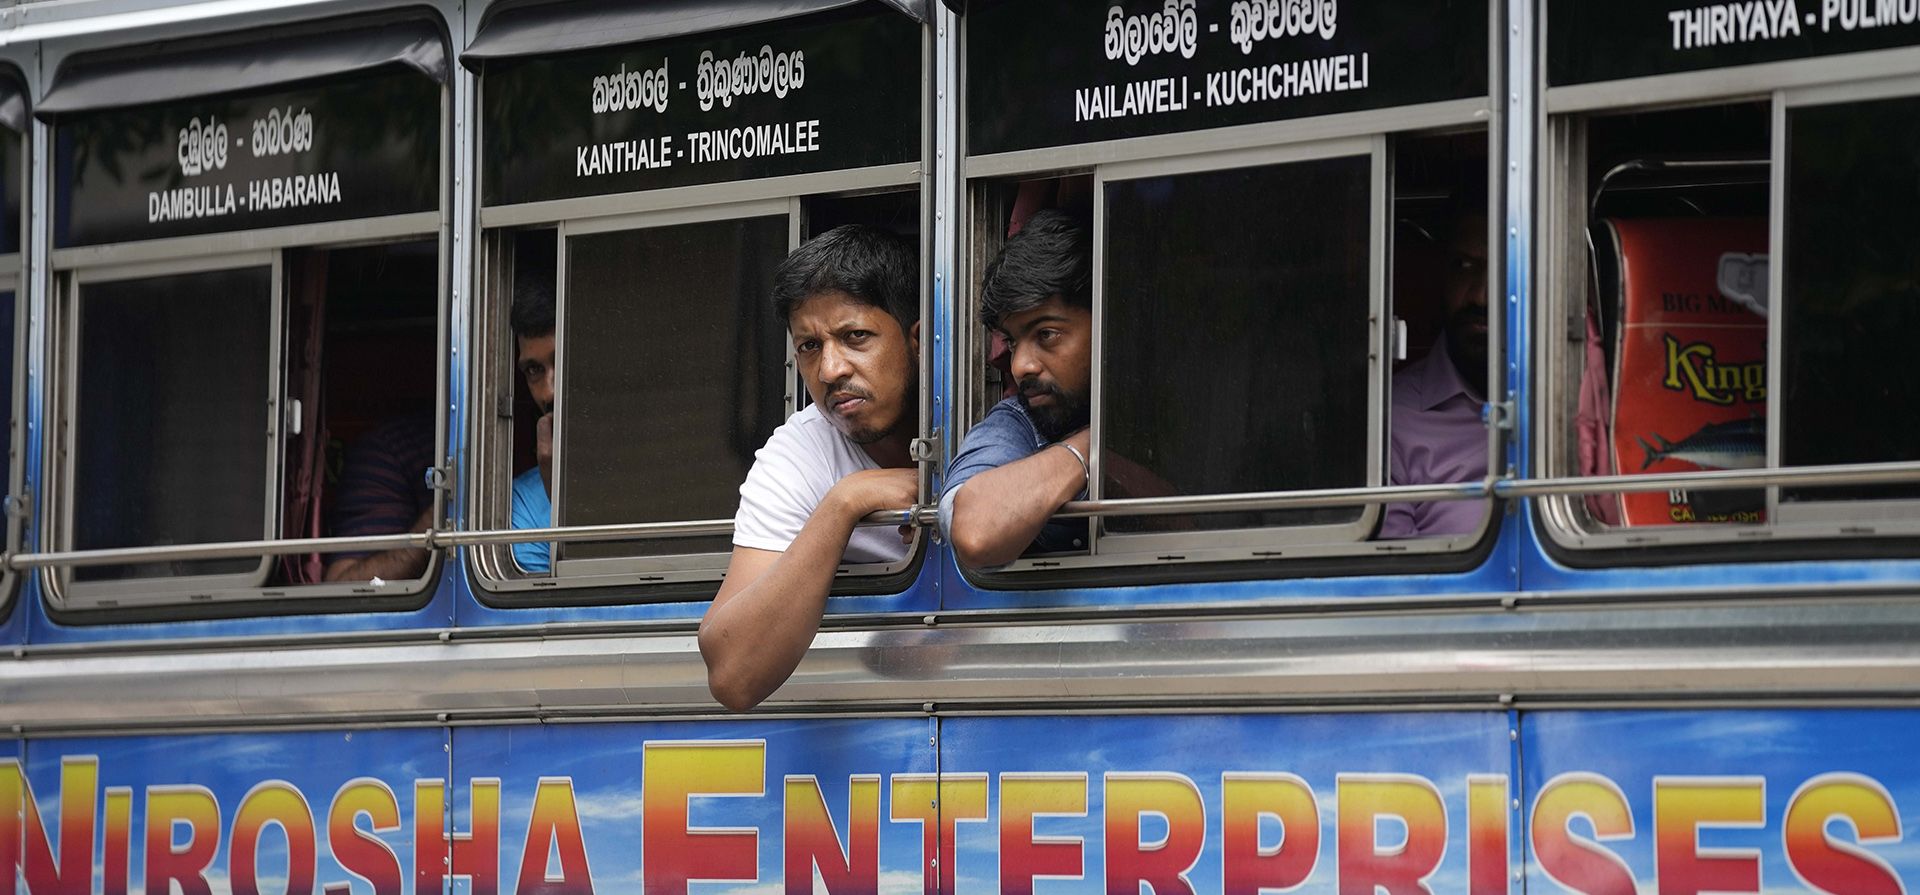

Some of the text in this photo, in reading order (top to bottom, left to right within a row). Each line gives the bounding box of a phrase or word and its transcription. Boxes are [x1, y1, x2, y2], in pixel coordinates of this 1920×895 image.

[1668, 0, 1801, 50] THIRIYAYA
[1822, 0, 1920, 33] PULMO
[592, 56, 668, 114] කන්තලේ
[1075, 76, 1187, 122] NAILAWELI
[1207, 52, 1369, 107] KUCHCHAWELI
[252, 105, 313, 157] හබරණ
[576, 136, 672, 177] KANTHALE
[688, 119, 820, 163] TRINCOMALEE
[149, 183, 236, 223] DAMBULLA
[249, 171, 342, 212] HABARANA
[0, 738, 1908, 895] NIROSHA ENTERPRISES
